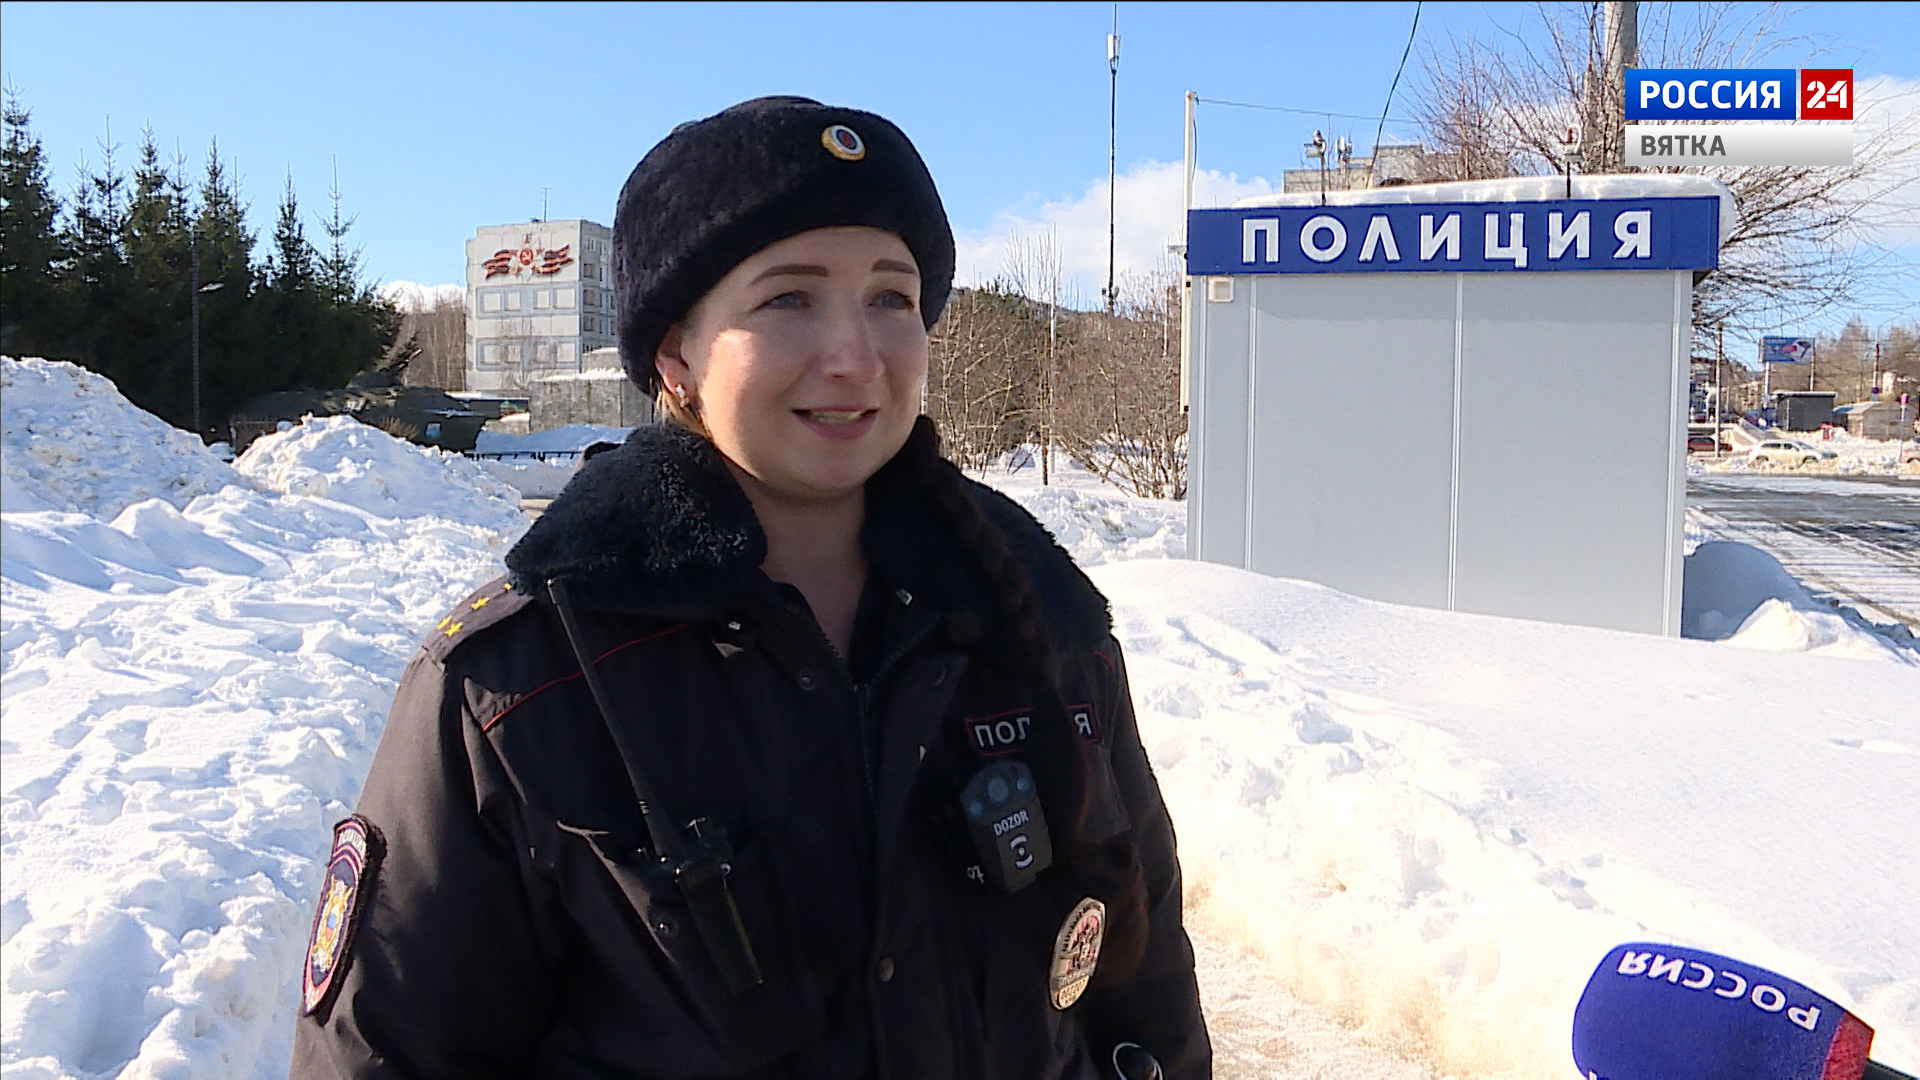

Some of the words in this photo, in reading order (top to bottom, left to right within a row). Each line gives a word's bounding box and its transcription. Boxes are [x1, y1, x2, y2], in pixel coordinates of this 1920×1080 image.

[1243, 210, 1653, 268] ПОЛИЦИЯ
[973, 712, 1093, 748] ПОЛЯ
[992, 809, 1030, 837] DOZOR
[1617, 950, 1821, 1031] РОССИЯ
